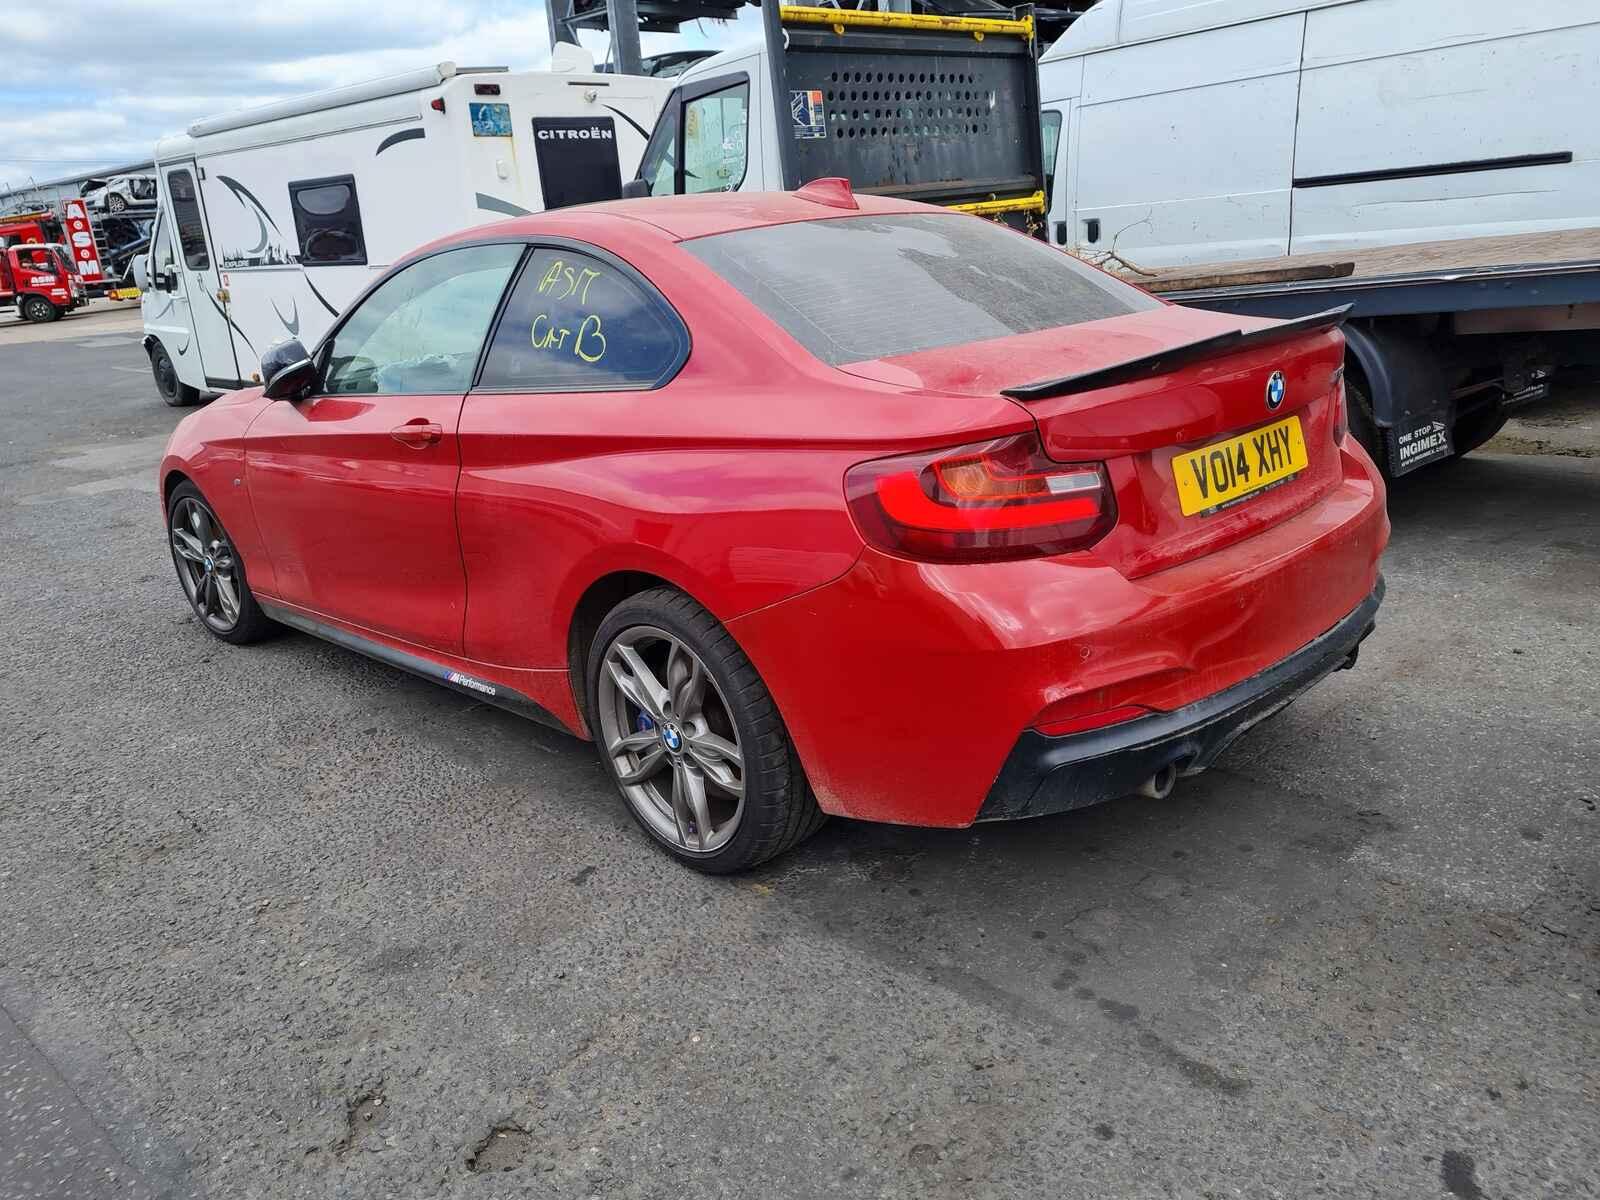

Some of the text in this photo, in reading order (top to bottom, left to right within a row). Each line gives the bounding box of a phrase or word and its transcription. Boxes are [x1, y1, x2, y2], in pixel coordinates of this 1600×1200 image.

[537, 127, 613, 140] CITROËN
[574, 314, 607, 363] B
[1398, 425, 1431, 445] ONE STOP
[1399, 430, 1447, 461] INGIMEX
[1190, 442, 1250, 499] VO14
[1252, 425, 1292, 478] XHY
